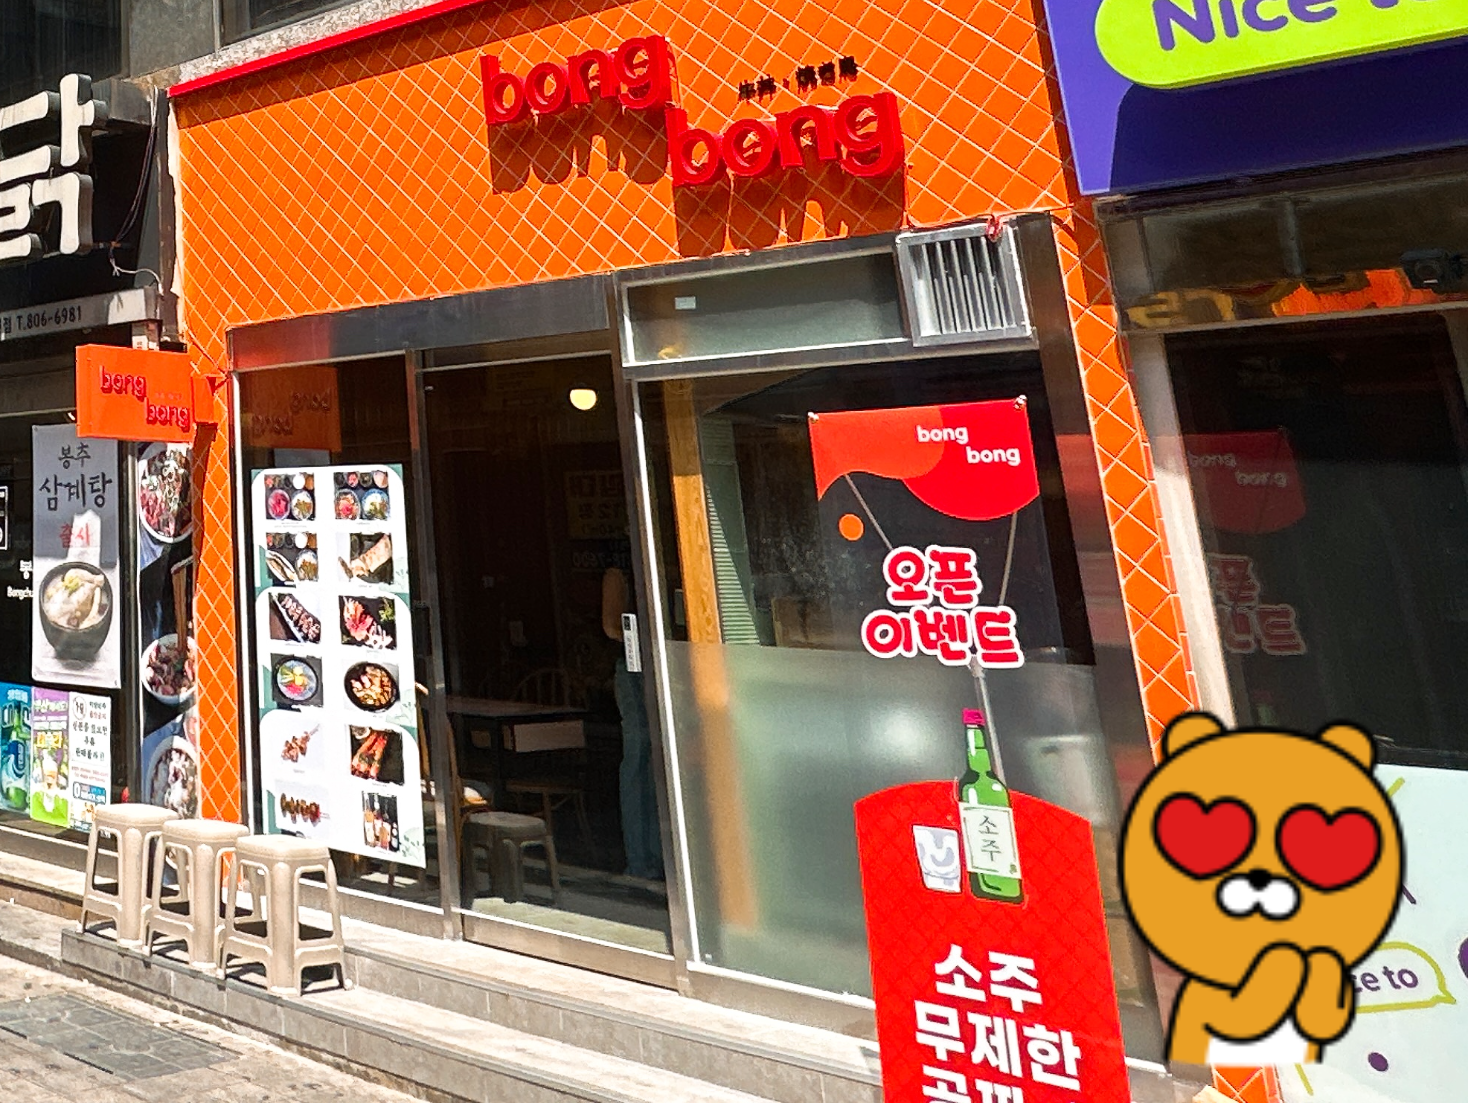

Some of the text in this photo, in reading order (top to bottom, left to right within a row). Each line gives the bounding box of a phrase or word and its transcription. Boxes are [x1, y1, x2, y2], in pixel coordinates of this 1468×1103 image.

[480, 35, 673, 126] bong
[665, 91, 906, 187] bong
[16, 305, 82, 331] T.806-6981
[99, 365, 147, 403] bong
[144, 396, 191, 434] bong
[916, 425, 969, 446] bong
[58, 442, 91, 469] 봉추
[965, 444, 1021, 467] bong
[39, 472, 113, 511] 삼계탕
[59, 522, 91, 548] 출시
[883, 544, 982, 609] 오픈
[861, 604, 1025, 669] 이벤트
[974, 811, 1004, 862] 소주
[934, 943, 1043, 1014] 소주
[1382, 965, 1419, 990] to
[914, 1000, 1082, 1091] 무제한
